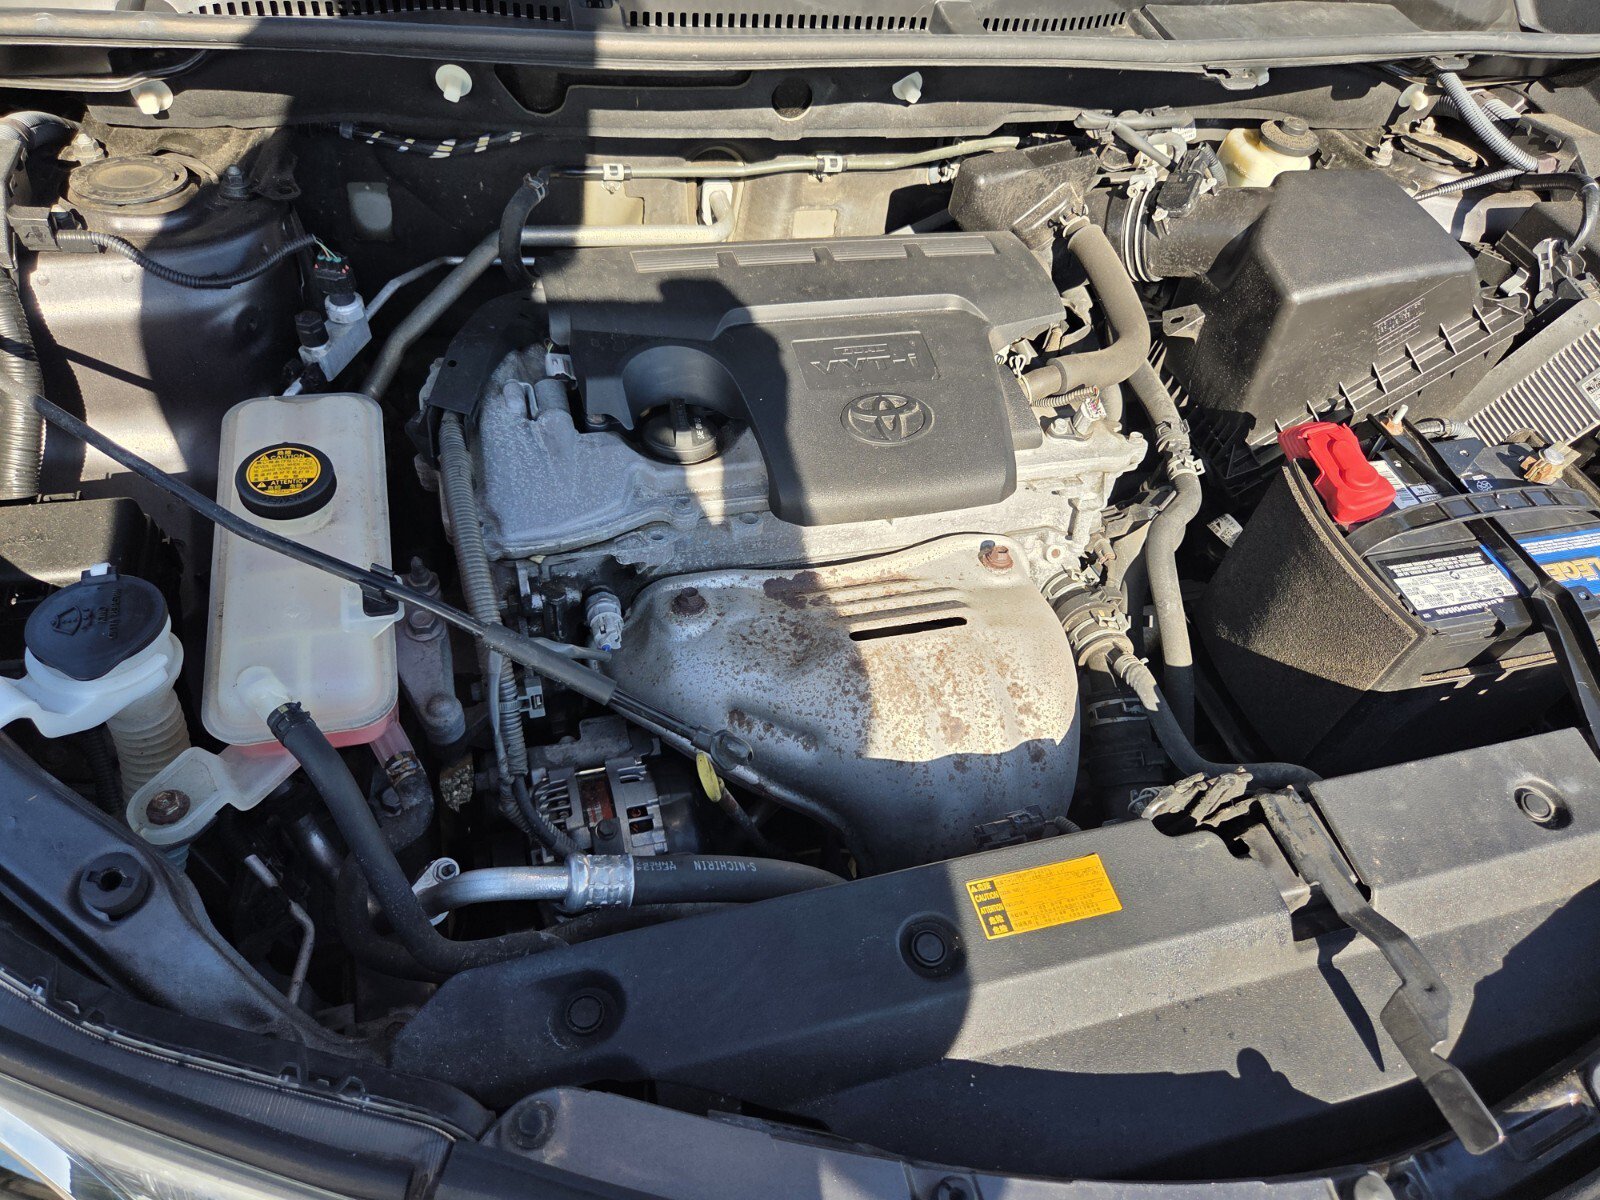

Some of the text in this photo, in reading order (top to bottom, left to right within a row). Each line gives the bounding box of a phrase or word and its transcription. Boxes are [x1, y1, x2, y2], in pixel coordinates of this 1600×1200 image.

[1541, 557, 1600, 581] LEGE
[974, 891, 999, 902] CAUTION
[980, 903, 1005, 915] ATTENTION
